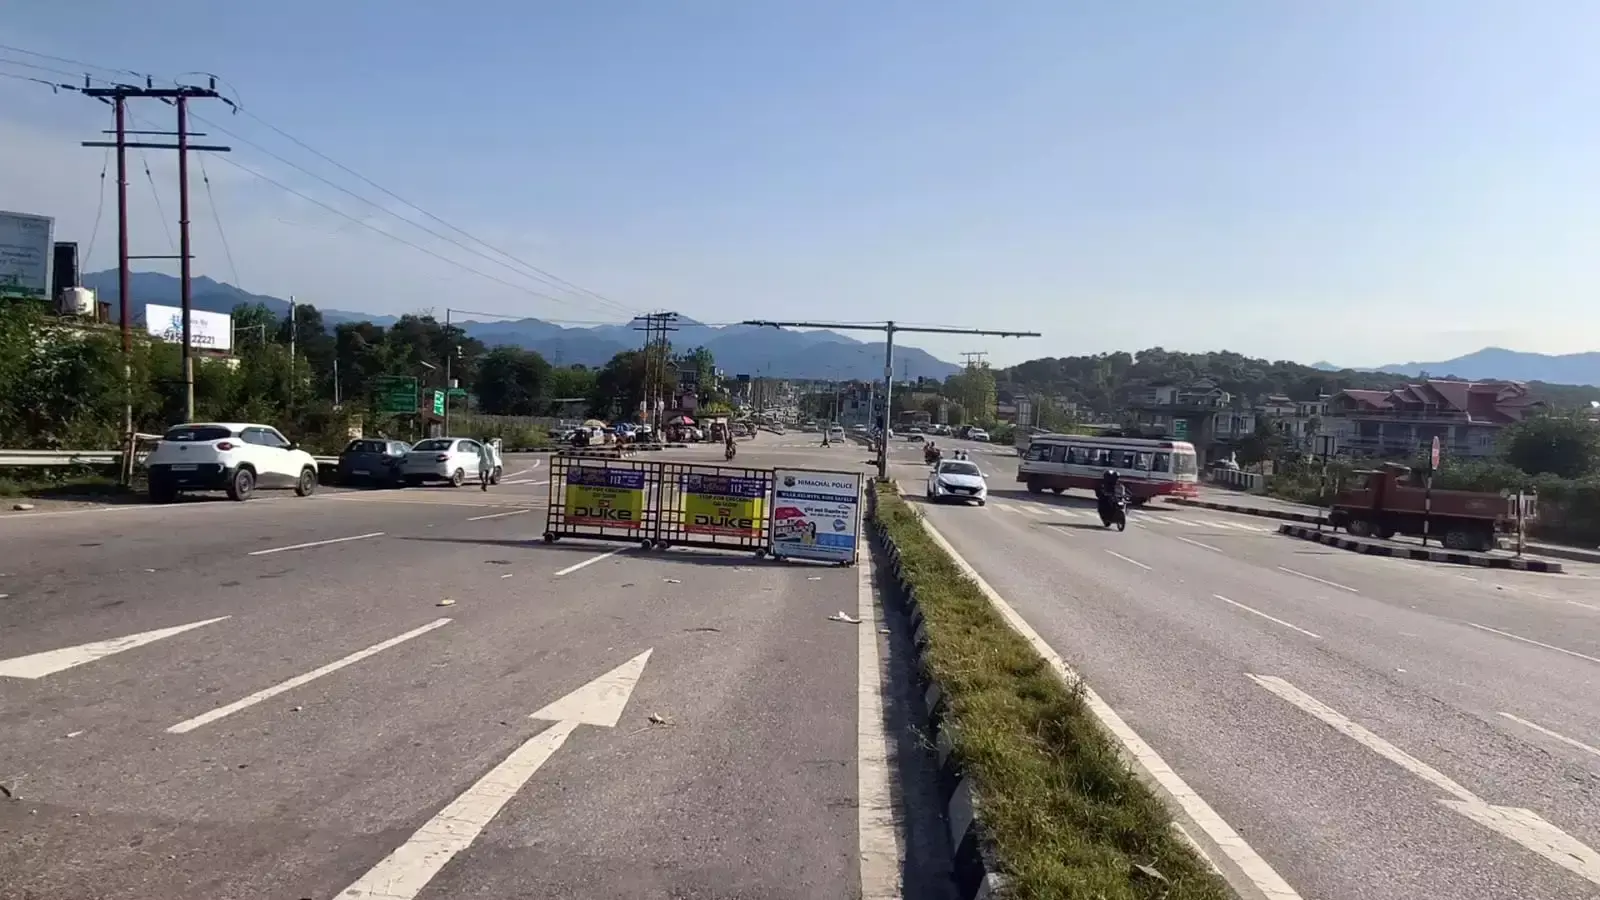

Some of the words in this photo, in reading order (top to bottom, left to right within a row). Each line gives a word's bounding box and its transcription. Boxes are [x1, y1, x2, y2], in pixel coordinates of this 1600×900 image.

[610, 475, 621, 485] 112
[797, 479, 830, 488] HIMACHAL
[831, 481, 853, 489] POLICE
[730, 483, 742, 493] 112
